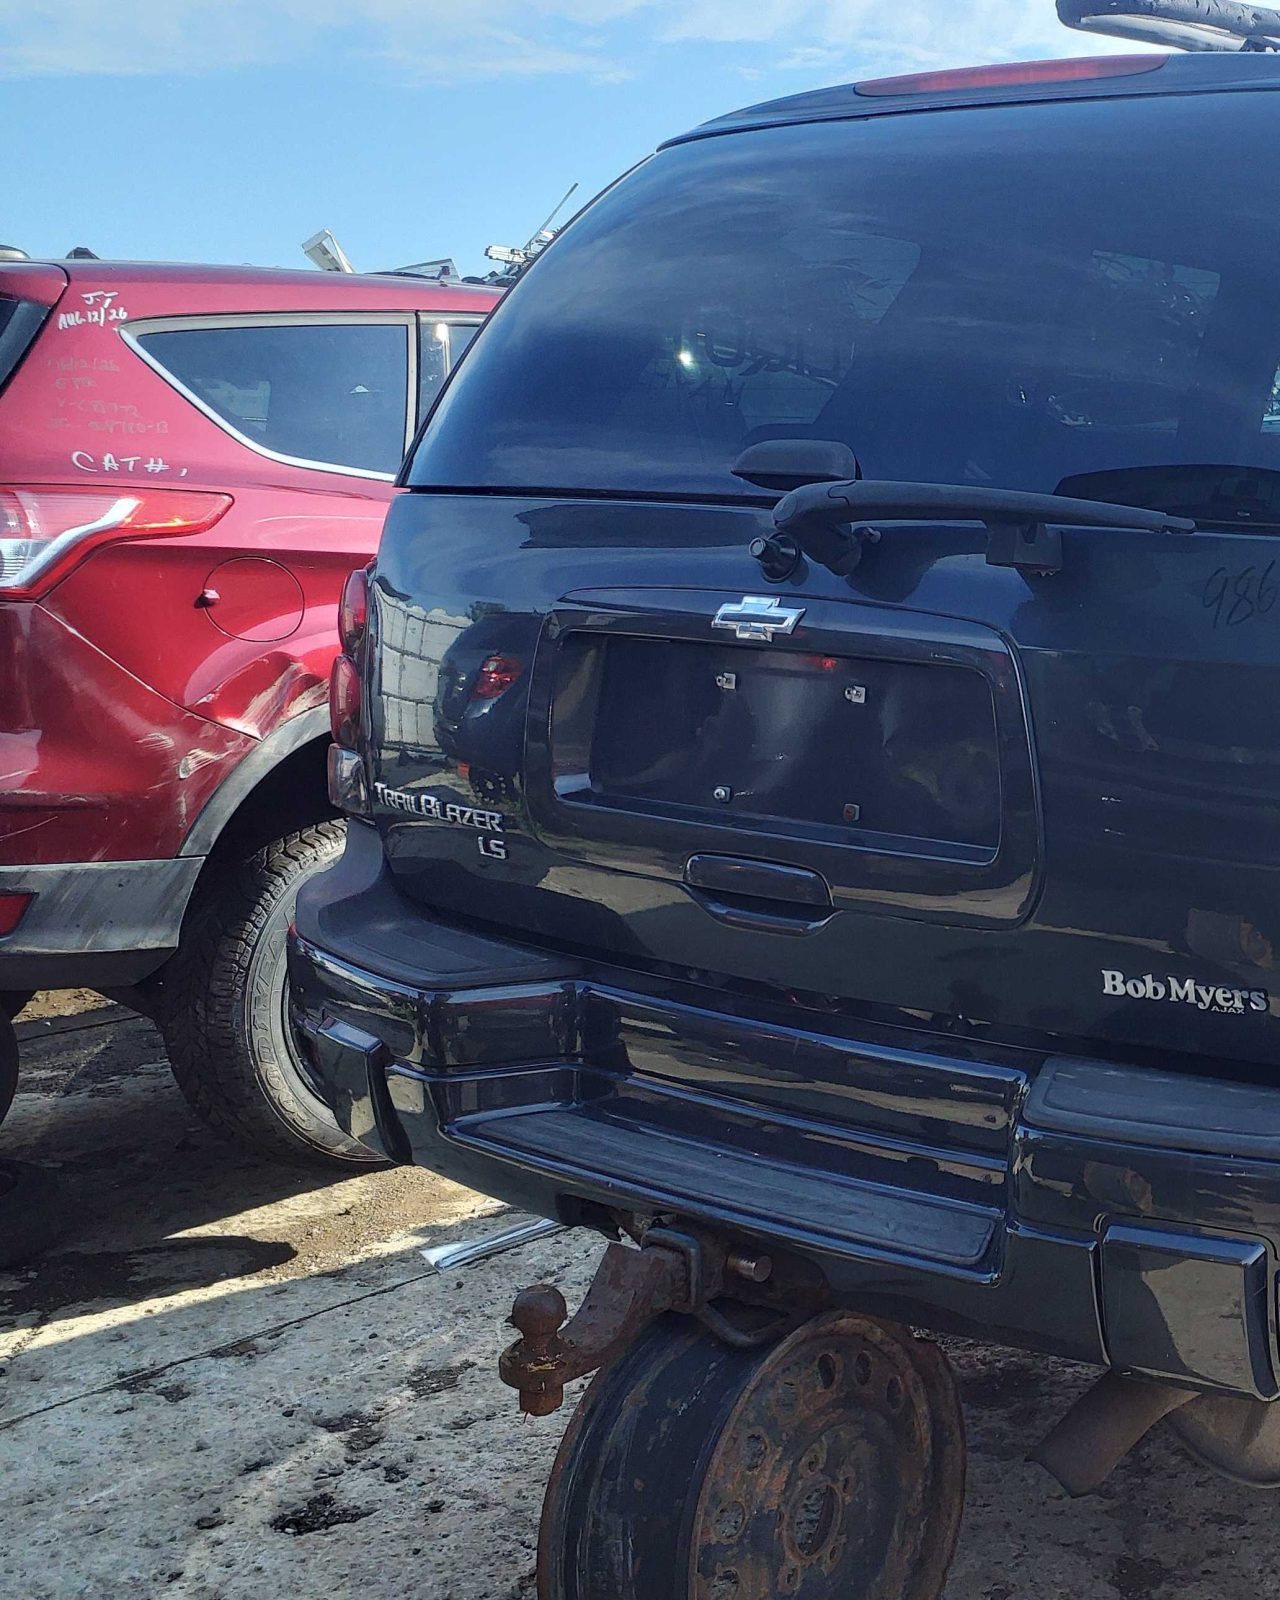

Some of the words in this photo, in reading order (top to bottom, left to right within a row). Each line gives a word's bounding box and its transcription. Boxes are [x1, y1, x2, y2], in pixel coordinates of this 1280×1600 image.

[477, 836, 507, 860] LS
[1167, 976, 1268, 1011] Myers
[1210, 1005, 1246, 1015] AJAX
